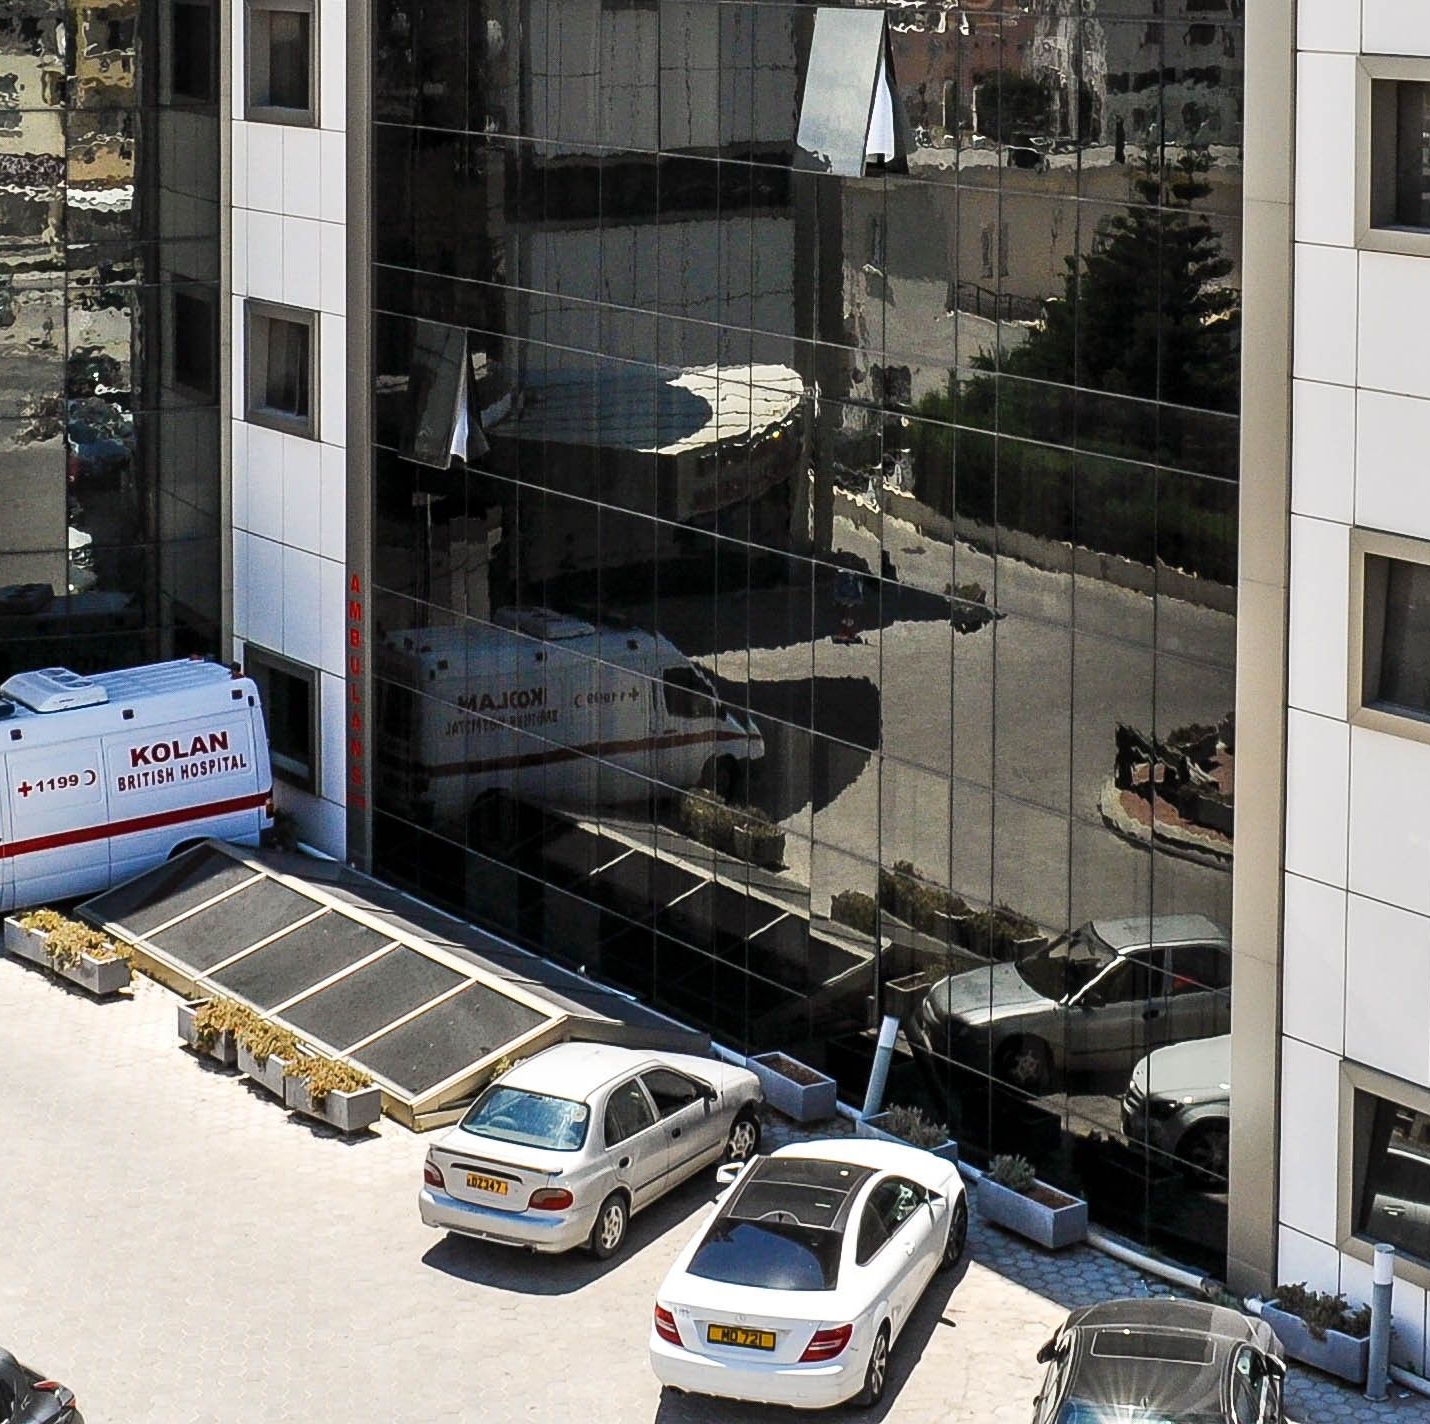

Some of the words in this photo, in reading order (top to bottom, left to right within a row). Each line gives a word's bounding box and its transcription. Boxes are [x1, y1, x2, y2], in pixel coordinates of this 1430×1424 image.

[348, 573, 363, 786] AMBULANS
[130, 731, 229, 768] KOLAN
[35, 774, 80, 793] 1199
[118, 766, 175, 792] BRITISH
[181, 754, 248, 781] HOSPITAL
[741, 1331, 763, 1346] 721
